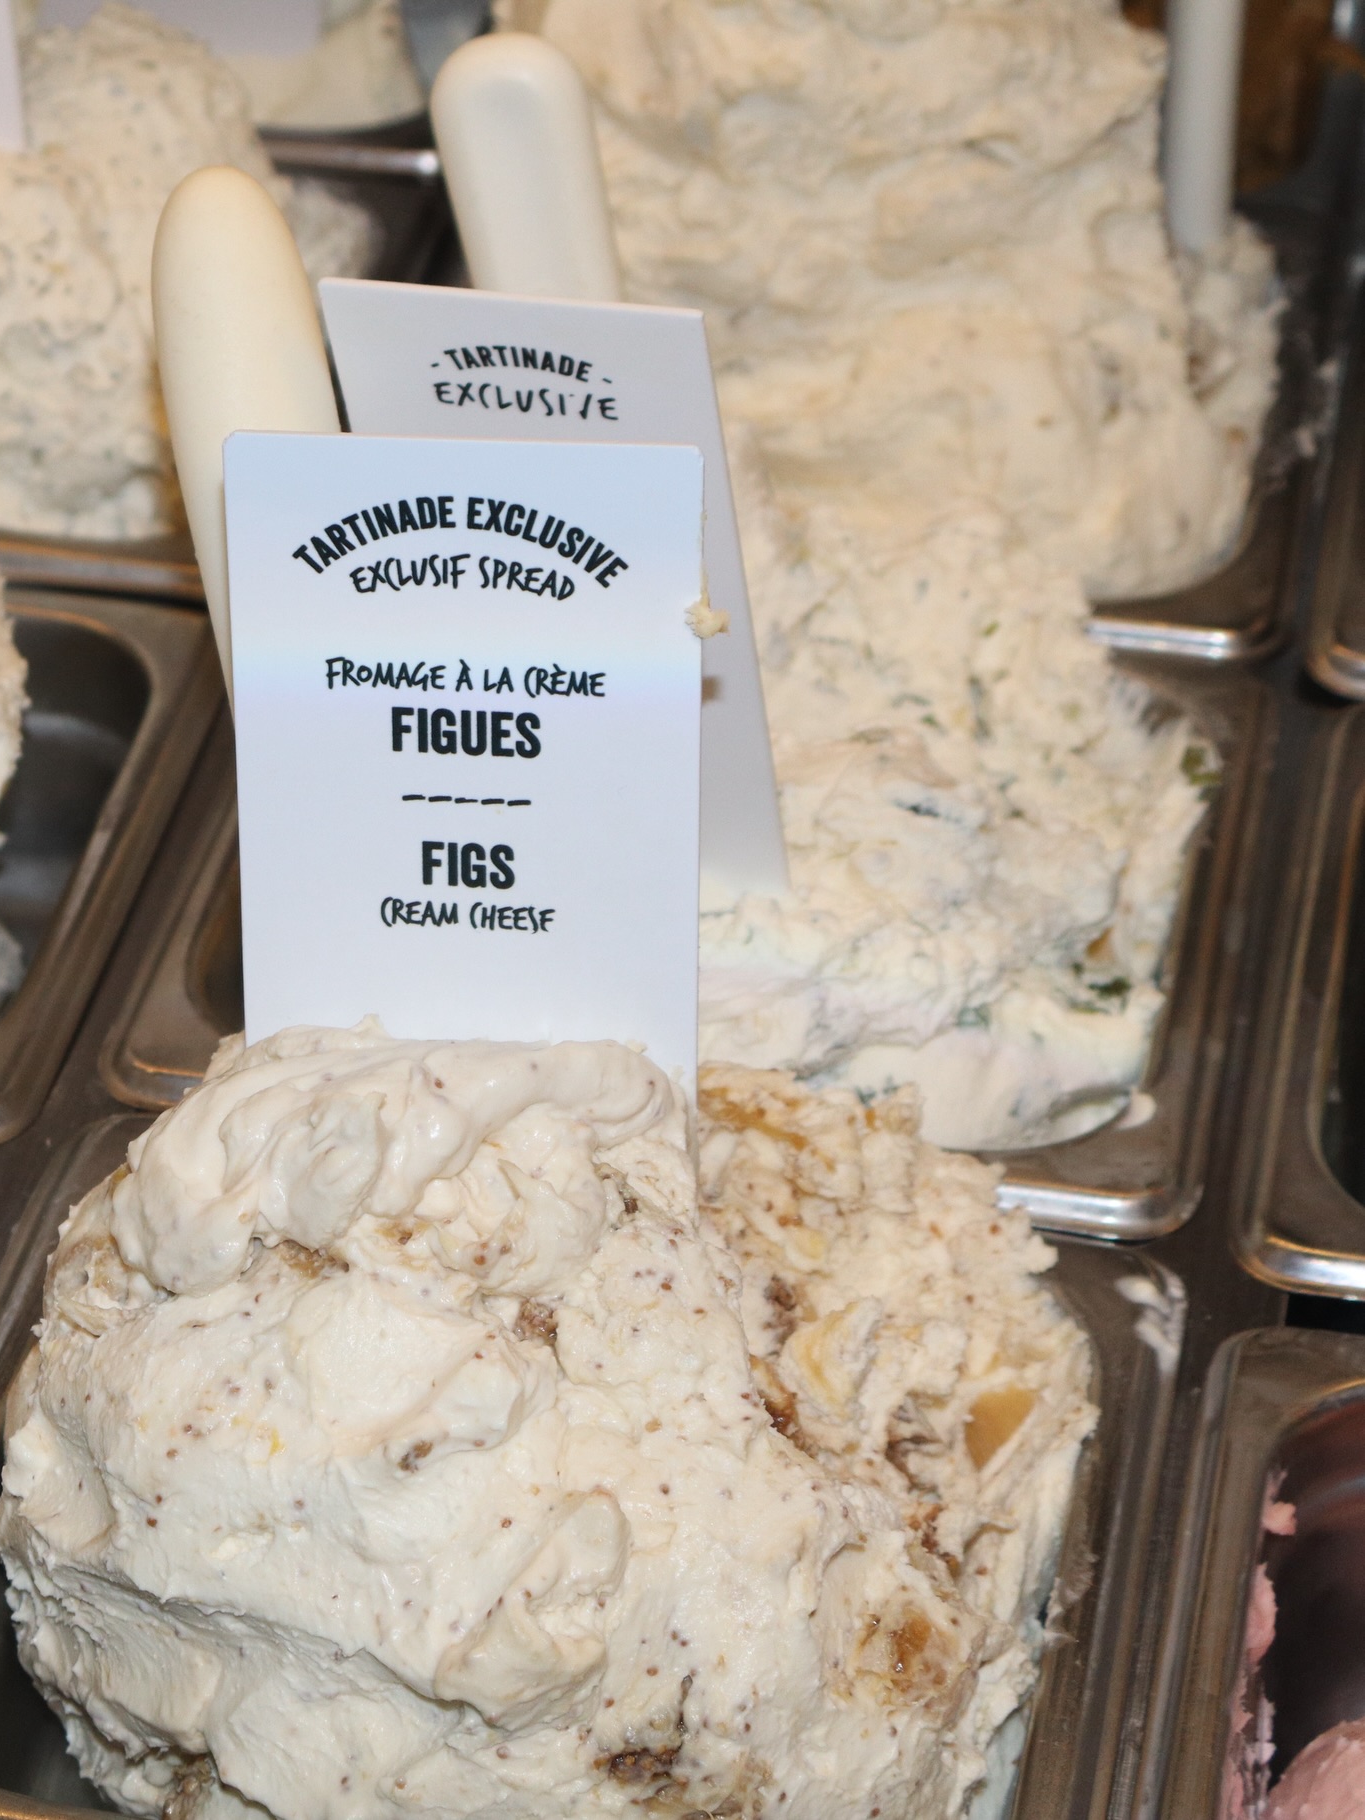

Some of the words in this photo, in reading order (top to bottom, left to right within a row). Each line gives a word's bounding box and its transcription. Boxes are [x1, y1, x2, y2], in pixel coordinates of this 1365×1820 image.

[442, 344, 593, 383] TARTINADE
[291, 495, 457, 575] TARTINADE
[466, 496, 629, 589] EXCLUSIVE
[348, 552, 472, 594] EXCLUSIF
[478, 555, 576, 602] SPREAD
[325, 656, 447, 692] FROMAGE
[454, 658, 474, 693] À
[483, 666, 515, 695] LA
[523, 662, 607, 699] CRÈME
[391, 706, 542, 759] FIGUES
[421, 840, 516, 890] FIGS
[379, 896, 459, 928] CREAM
